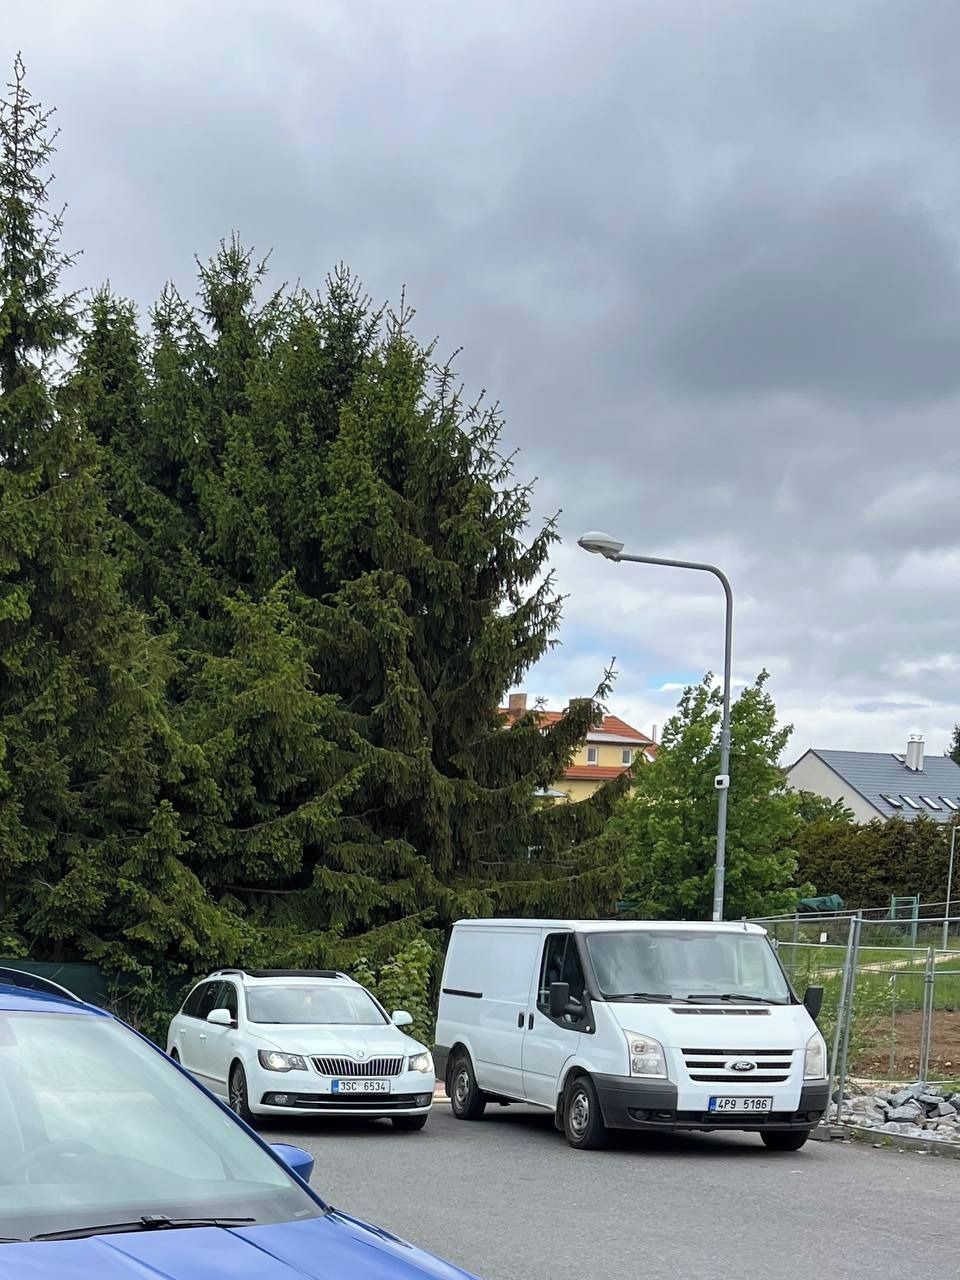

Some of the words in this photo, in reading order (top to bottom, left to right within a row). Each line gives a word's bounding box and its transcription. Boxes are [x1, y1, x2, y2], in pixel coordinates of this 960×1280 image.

[340, 1081, 357, 1091] 3SC
[364, 1081, 386, 1091] 6534
[718, 1099, 737, 1110] 4P9
[743, 1099, 768, 1110] 5186
